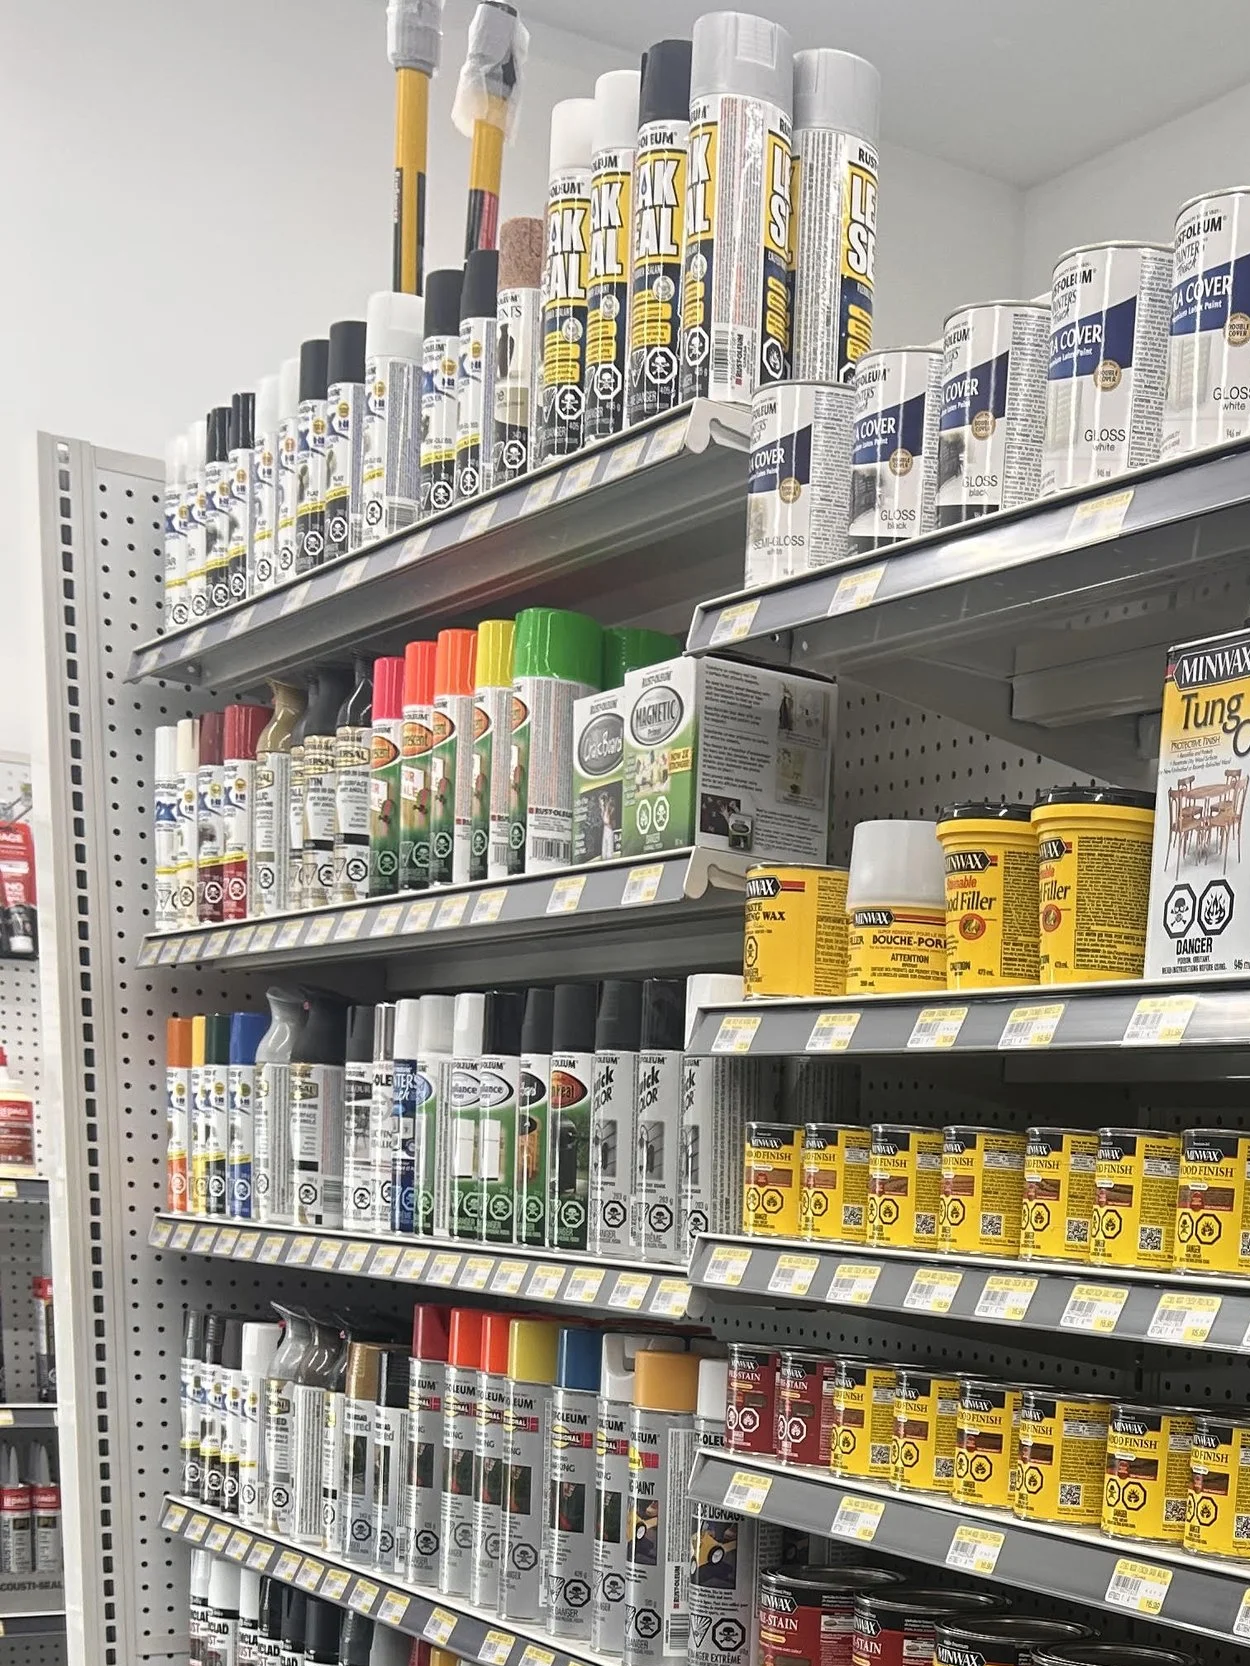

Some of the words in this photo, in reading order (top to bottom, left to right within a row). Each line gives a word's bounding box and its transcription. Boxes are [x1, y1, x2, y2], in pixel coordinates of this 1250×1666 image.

[1222, 400, 1245, 411] white
[862, 417, 896, 437] COVER
[1085, 428, 1125, 443] GLOSS
[963, 475, 998, 488] GLOSS
[881, 510, 915, 522] GLOSS
[633, 701, 679, 728] MAGNETIC
[1181, 692, 1243, 731] Tung
[959, 893, 996, 911] Filler
[763, 910, 785, 921] WAX
[1176, 938, 1212, 954] DANGER
[891, 954, 929, 964] ATTENTION
